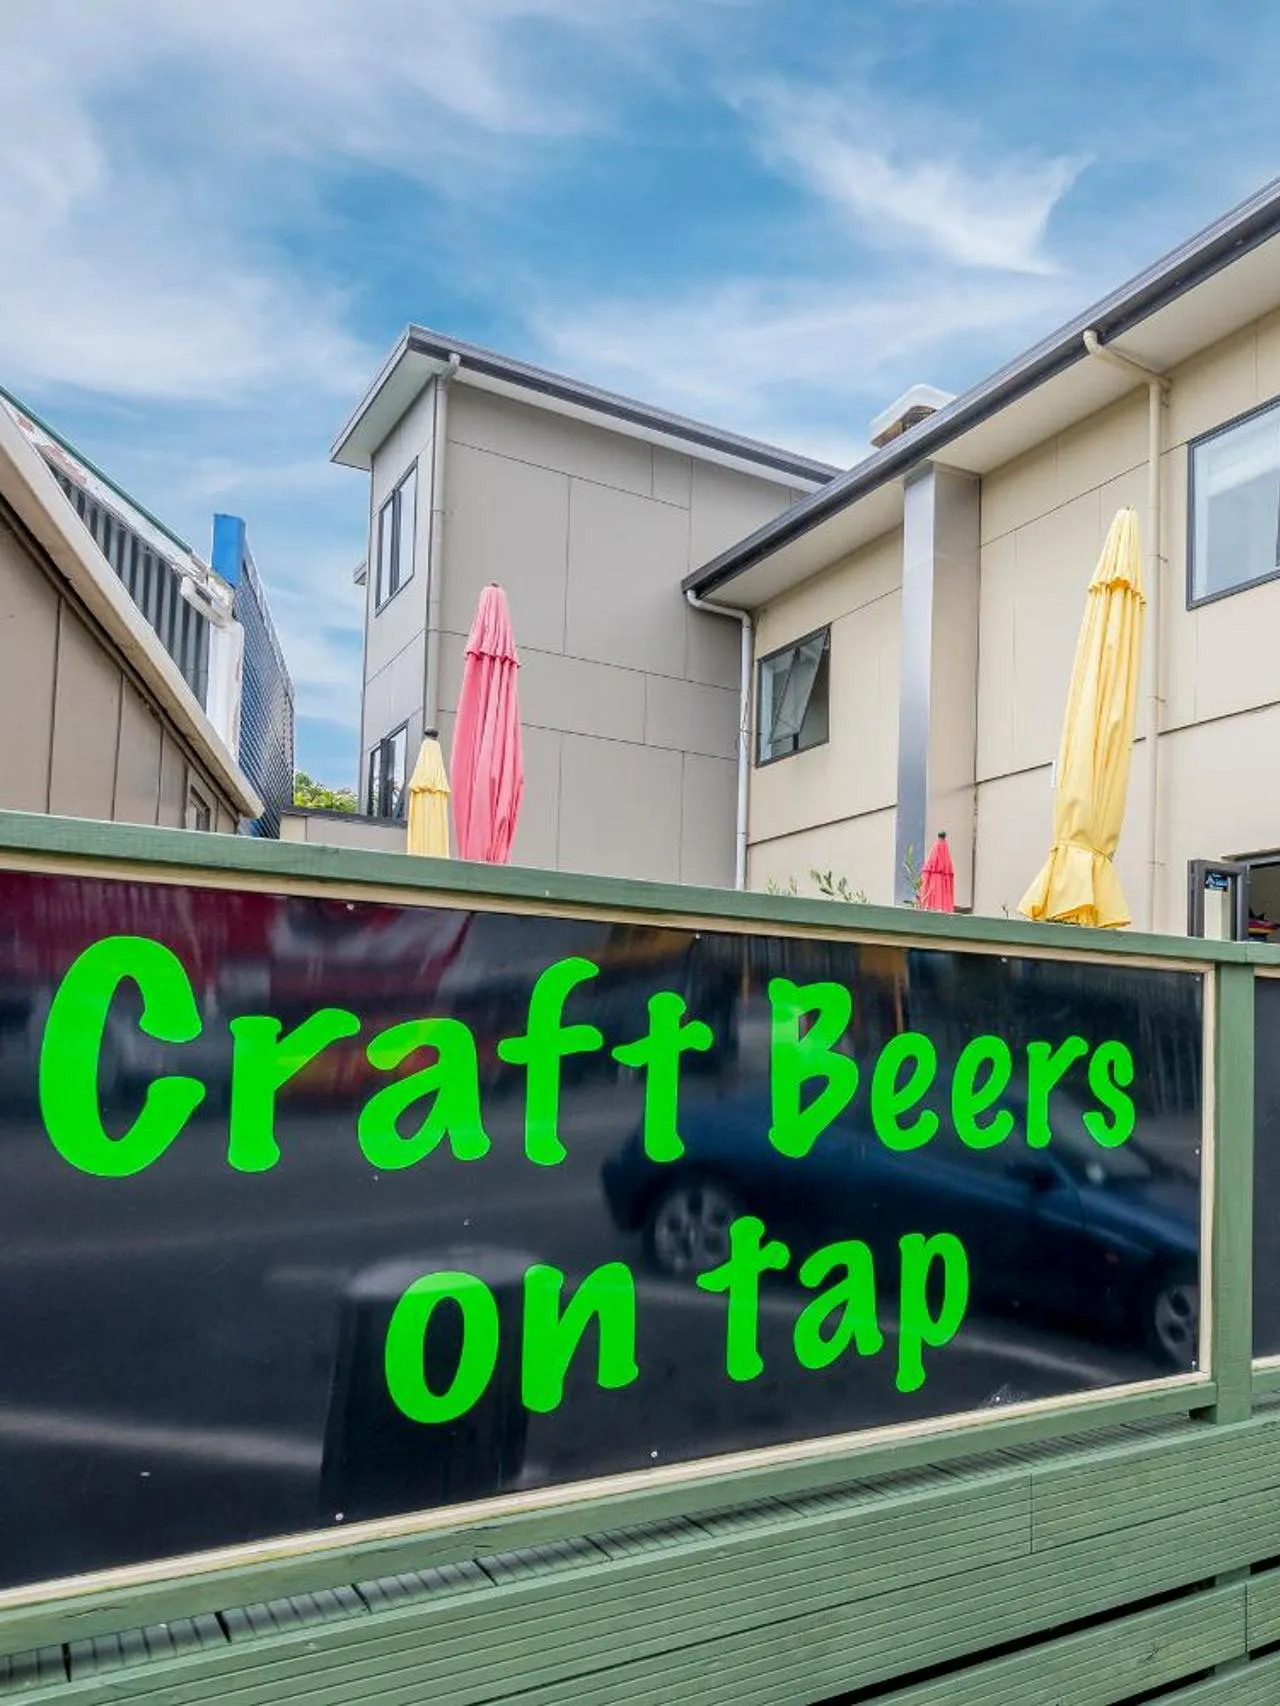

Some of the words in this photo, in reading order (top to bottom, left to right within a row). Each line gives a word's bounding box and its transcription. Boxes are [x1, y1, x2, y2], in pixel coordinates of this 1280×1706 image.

[38, 935, 714, 1178] Craft
[767, 977, 1136, 1158] Beers
[384, 1261, 640, 1424] on
[695, 1215, 969, 1394] tap
